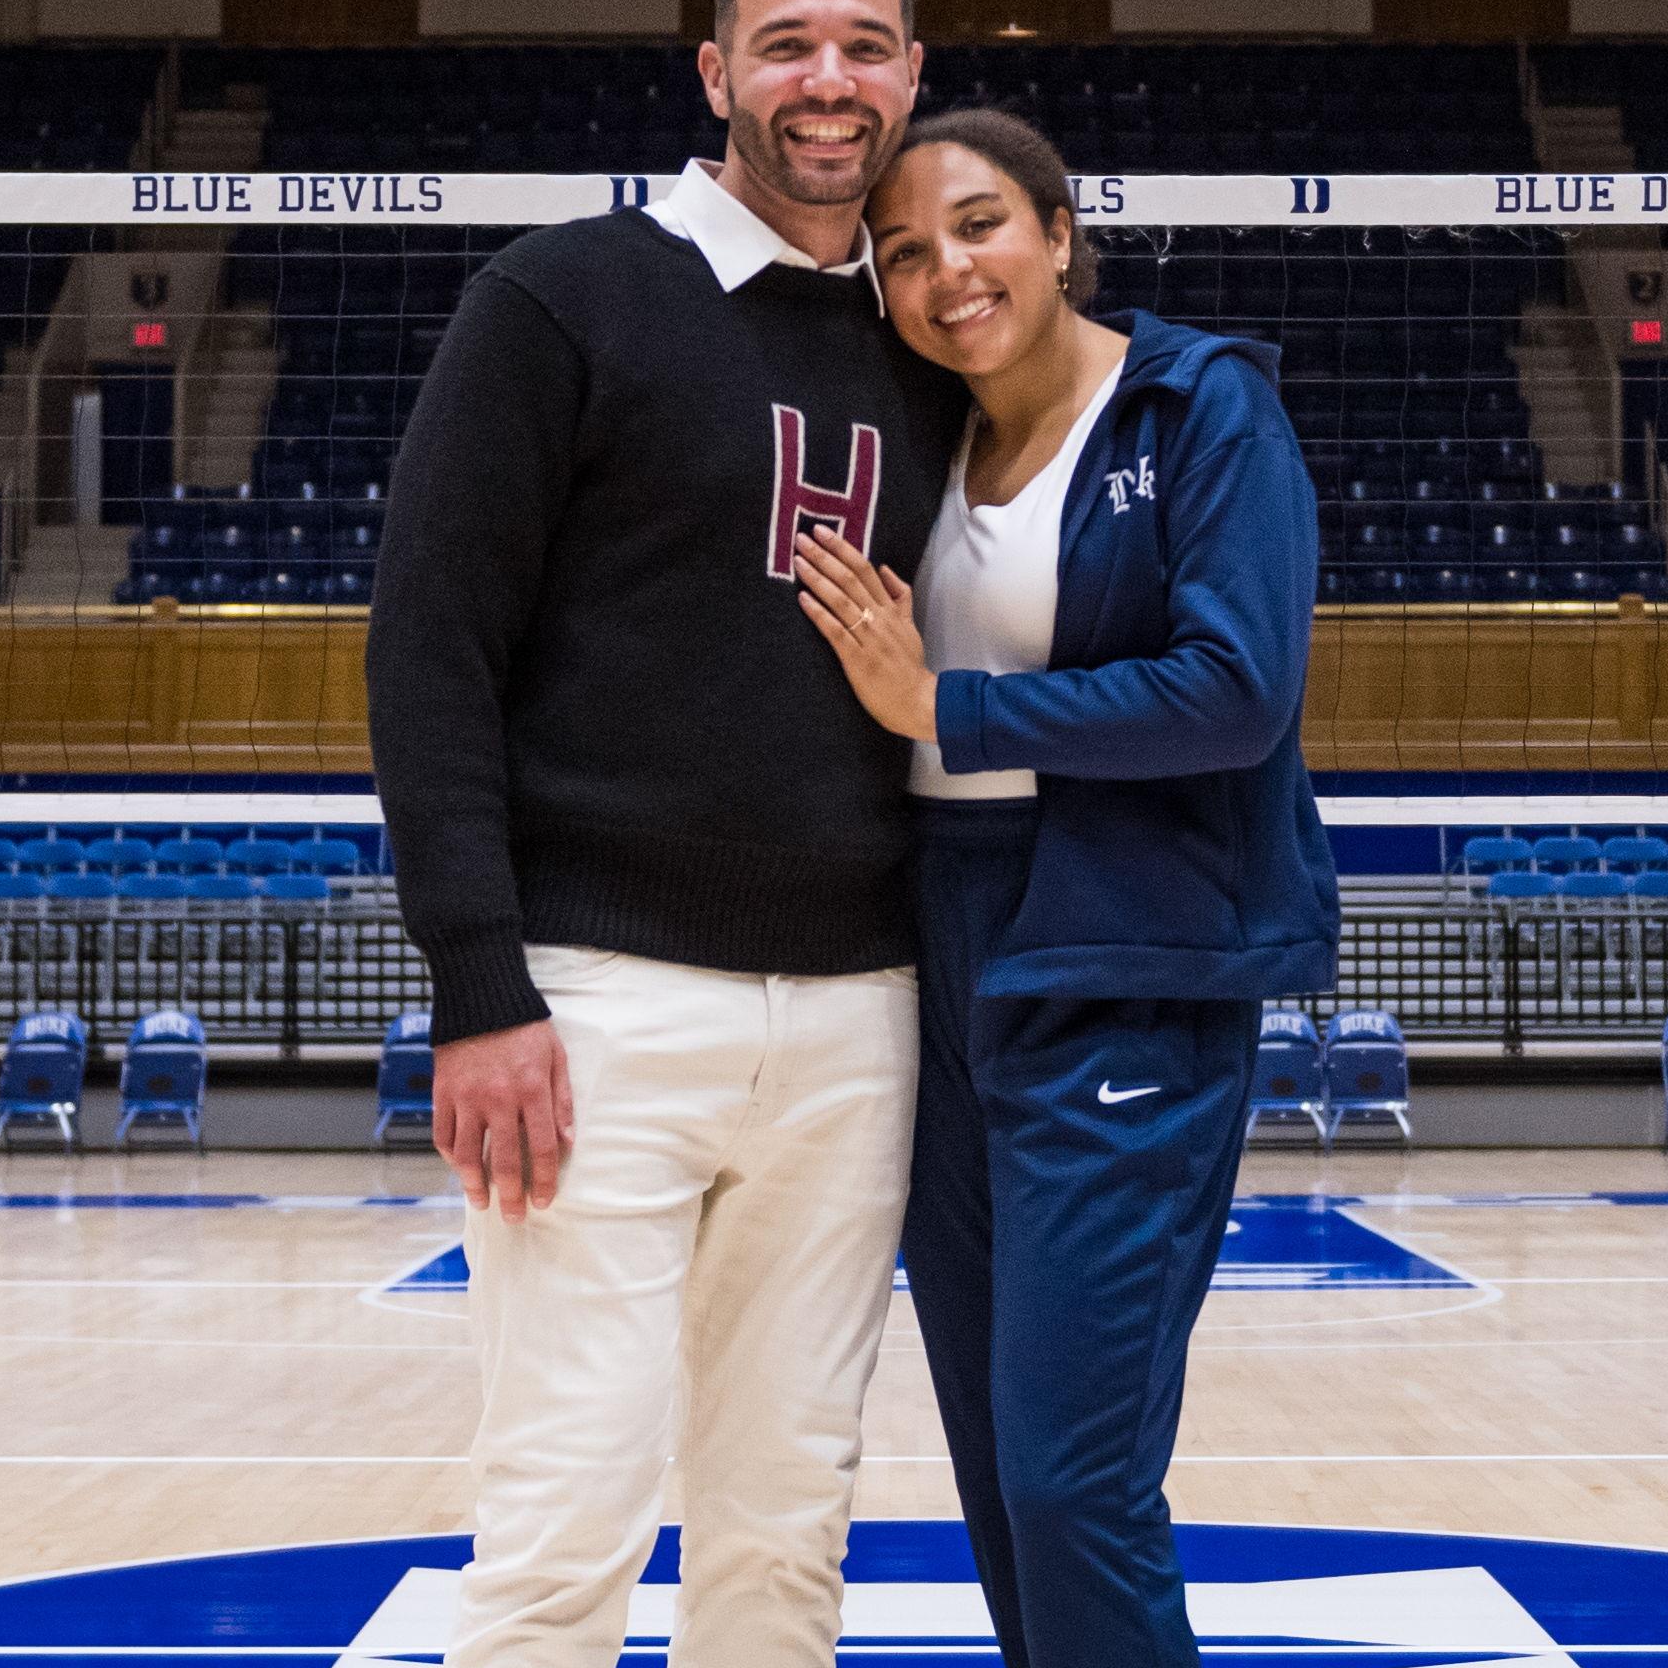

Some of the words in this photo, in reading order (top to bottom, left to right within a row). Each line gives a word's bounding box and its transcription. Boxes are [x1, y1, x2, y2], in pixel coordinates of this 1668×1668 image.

[132, 176, 252, 212] BLUE
[278, 176, 443, 212] DEVILS
[1495, 176, 1616, 213] BLUE
[767, 403, 881, 582] H
